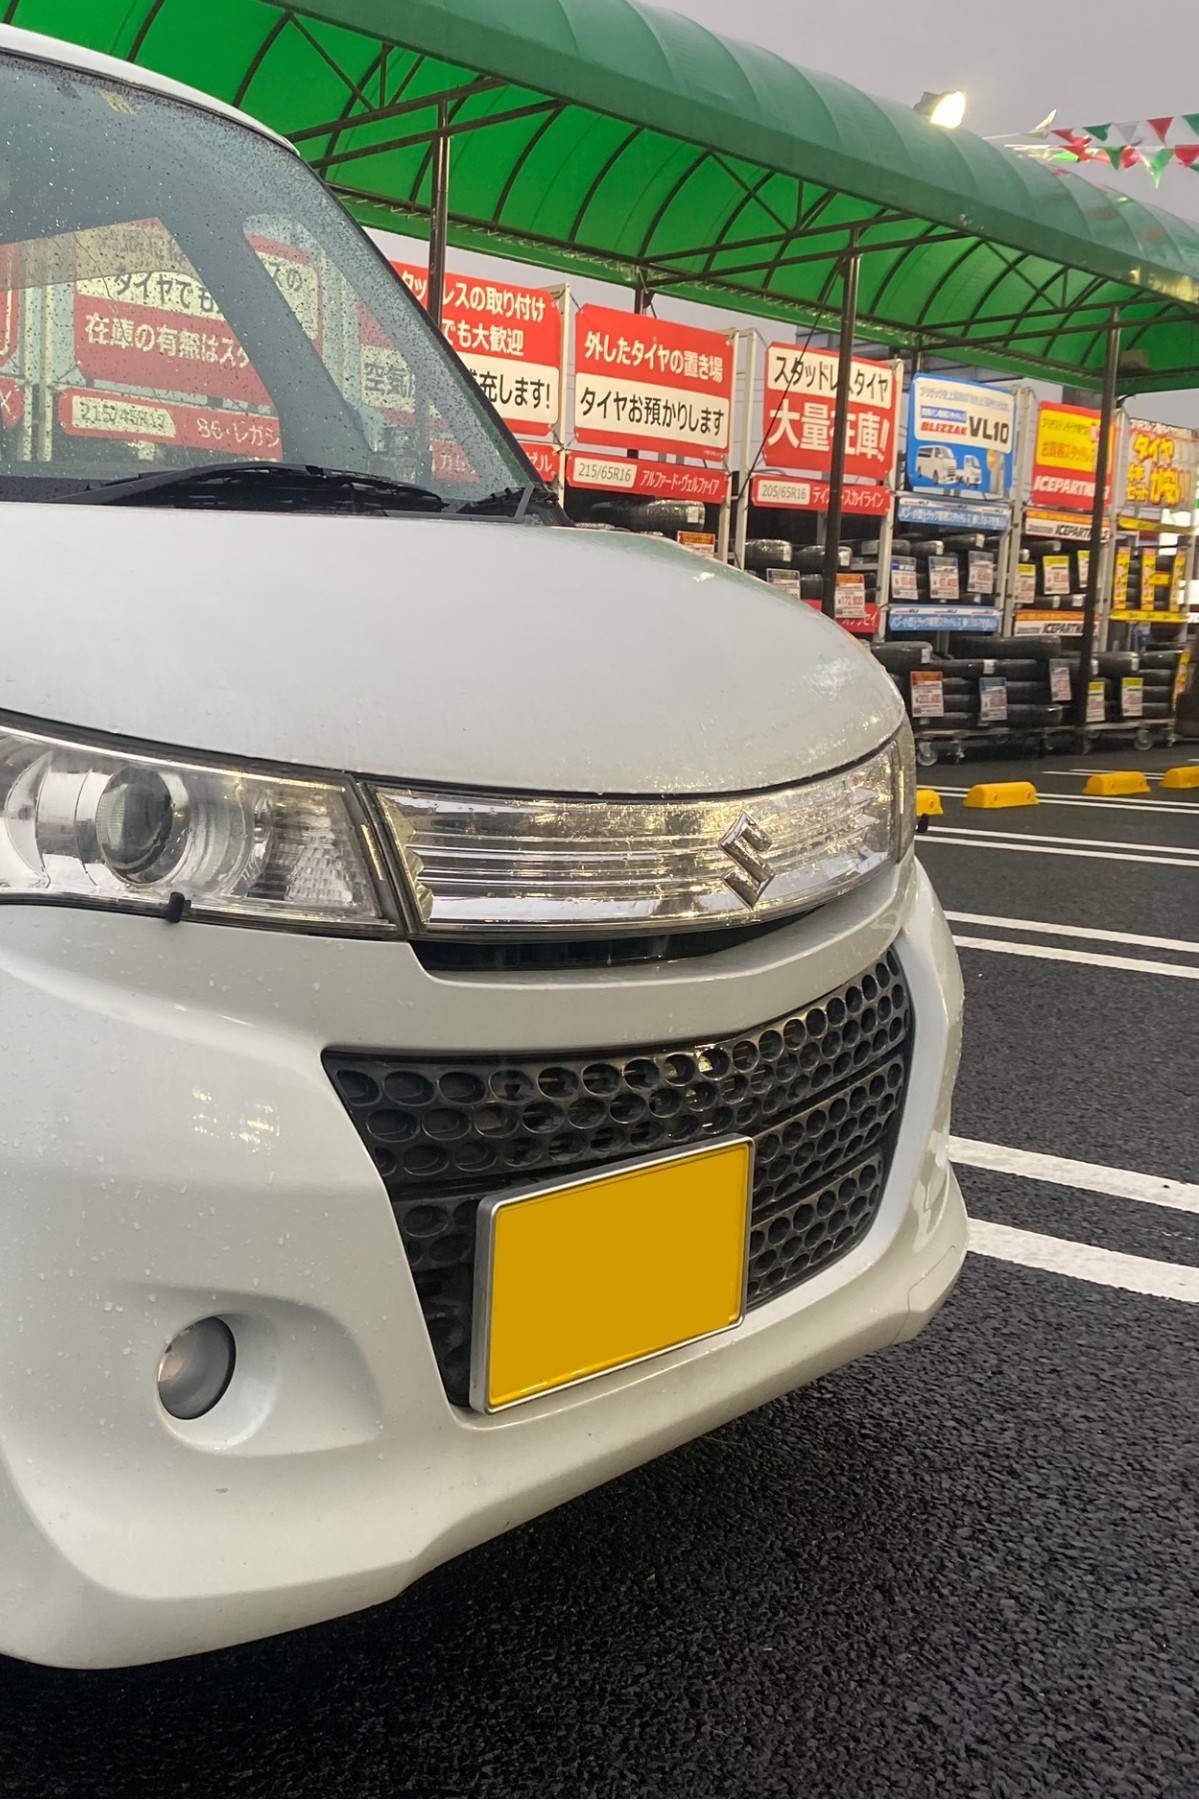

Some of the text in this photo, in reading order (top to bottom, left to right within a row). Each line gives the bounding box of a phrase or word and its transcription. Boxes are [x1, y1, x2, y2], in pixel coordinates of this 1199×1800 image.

[401, 270, 546, 323] タッレスの取り付け
[584, 330, 724, 384] 外したタイヤの置き場
[774, 355, 889, 402] スタッドレタイヤ
[470, 369, 550, 409] 充します!
[580, 387, 724, 436] タイヤお預かりします
[920, 415, 1009, 444] BLIZZAK VL10
[578, 462, 632, 482] 215/65R16
[761, 483, 807, 500] 205/65R16
